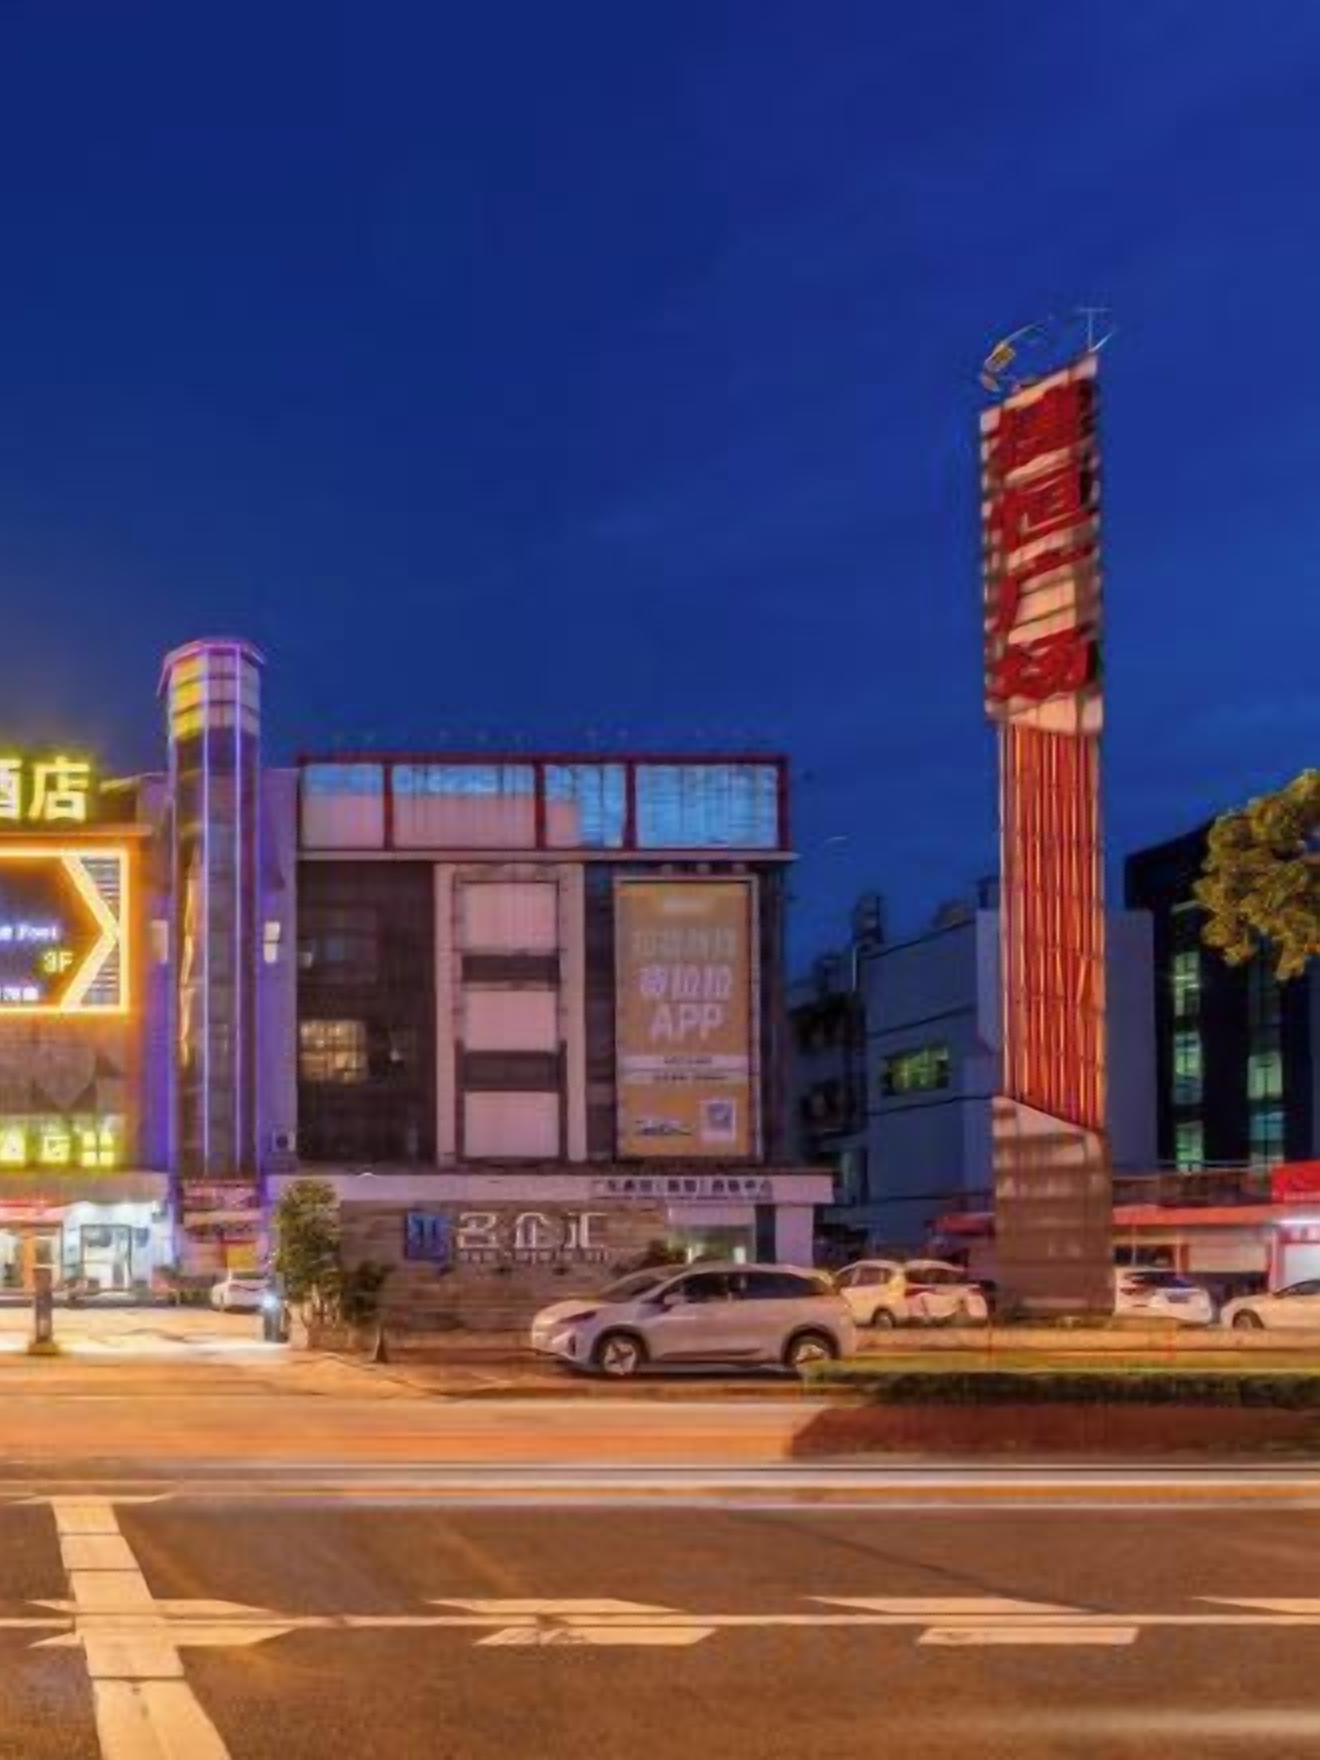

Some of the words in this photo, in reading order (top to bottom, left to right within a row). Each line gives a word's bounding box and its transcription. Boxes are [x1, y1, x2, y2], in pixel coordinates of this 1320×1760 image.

[42, 951, 73, 973] 3F
[649, 1002, 726, 1042] APP
[456, 1211, 610, 1249] 名企汇
